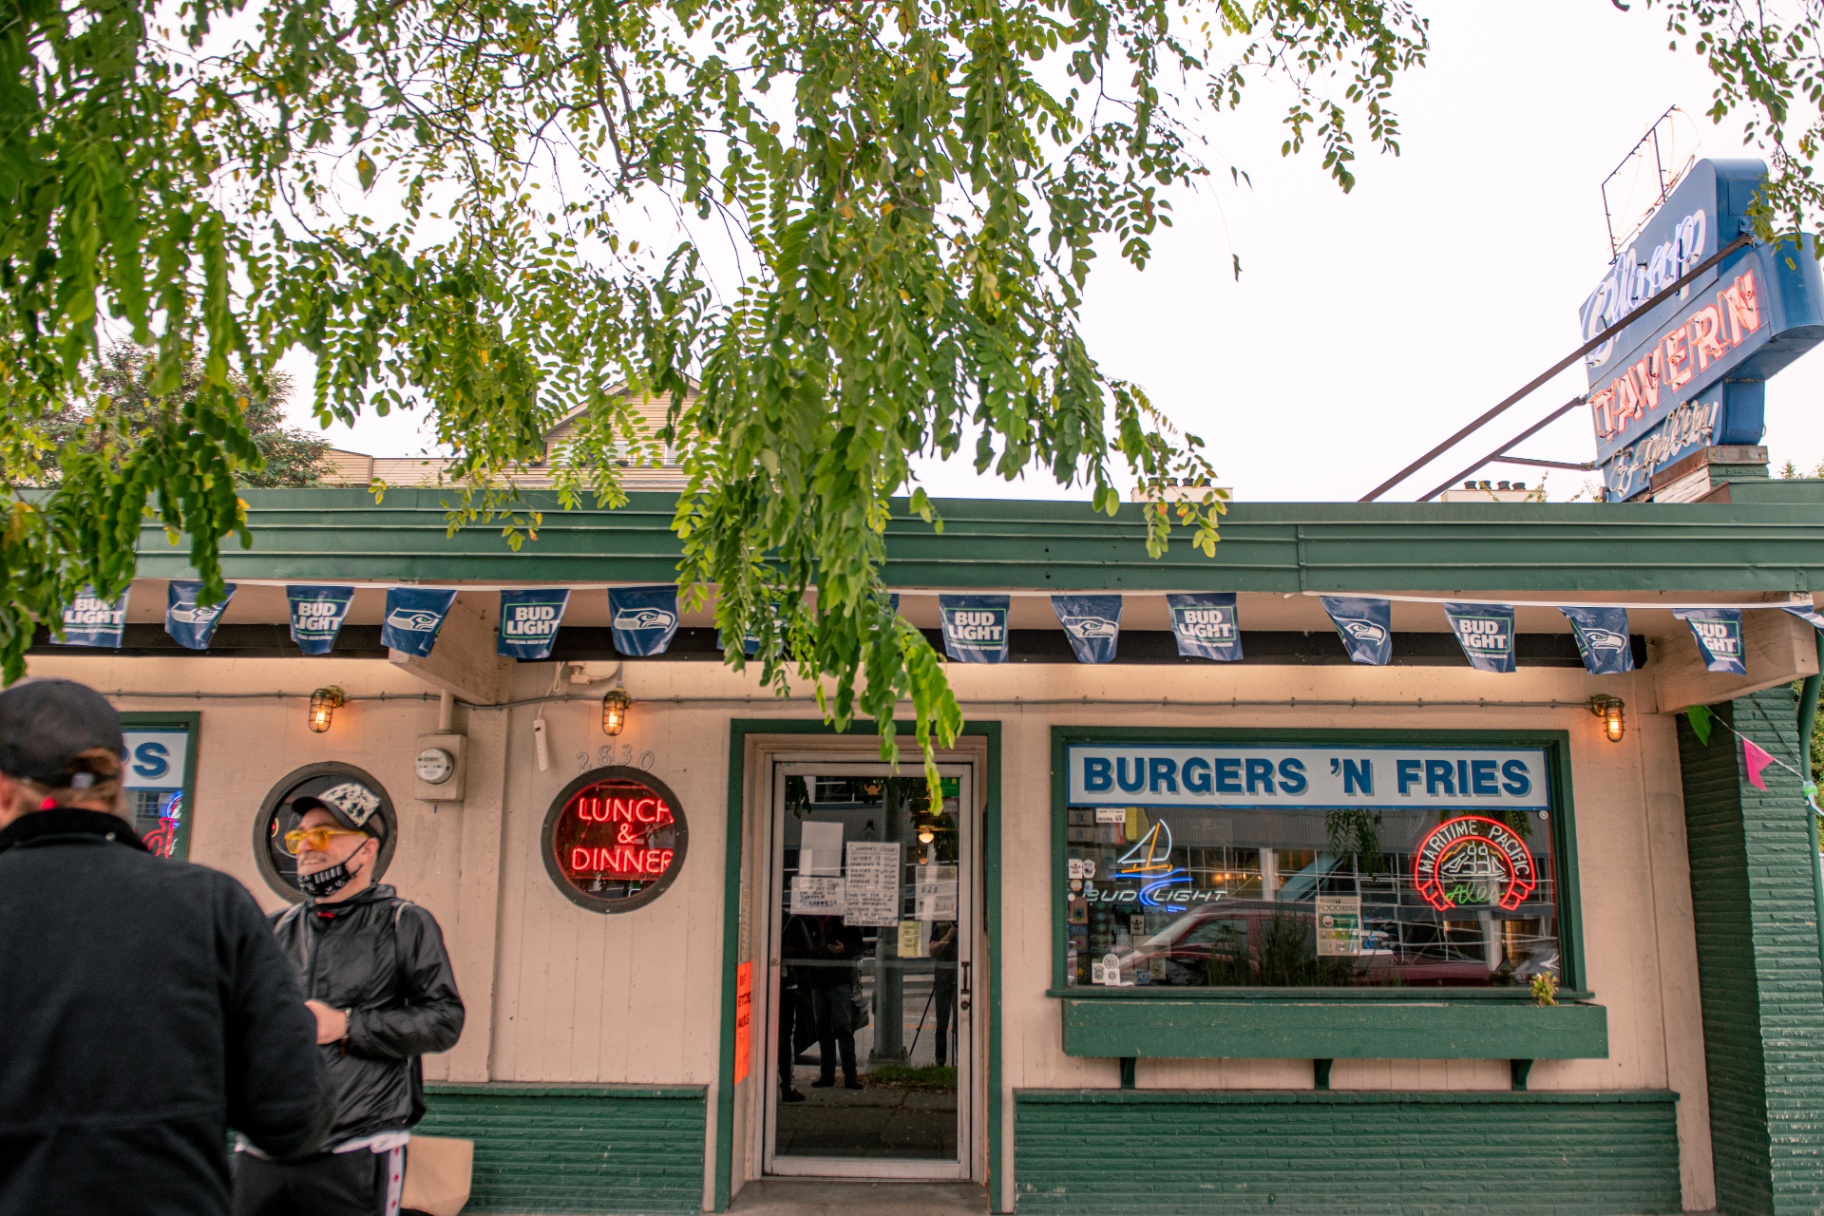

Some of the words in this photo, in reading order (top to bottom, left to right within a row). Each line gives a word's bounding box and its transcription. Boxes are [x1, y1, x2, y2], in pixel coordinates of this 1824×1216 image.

[1588, 268, 1760, 442] TAVERN
[63, 610, 122, 624] LIGHT
[298, 602, 337, 616] BUD
[515, 606, 555, 620] BUD
[1184, 610, 1222, 624] BUD
[955, 611, 994, 626] BUD
[506, 620, 560, 634] LIGHT
[948, 625, 1002, 640] LIGHT
[1179, 624, 1231, 638] LIGHT
[1460, 619, 1498, 635] BUD
[1463, 633, 1506, 649] IGHT
[577, 745, 655, 773] 2830
[1084, 757, 1308, 795] BURGERS
[1330, 758, 1373, 795] 'N
[1396, 759, 1532, 796] FRIES
[578, 798, 674, 823] LUNCH
[617, 822, 637, 844] &
[1418, 820, 1479, 874] MARITIME
[1487, 825, 1530, 876] PACIFIC
[572, 847, 674, 873] DINNER
[1152, 889, 1227, 902] LIGHT
[1446, 881, 1505, 905] Ales
